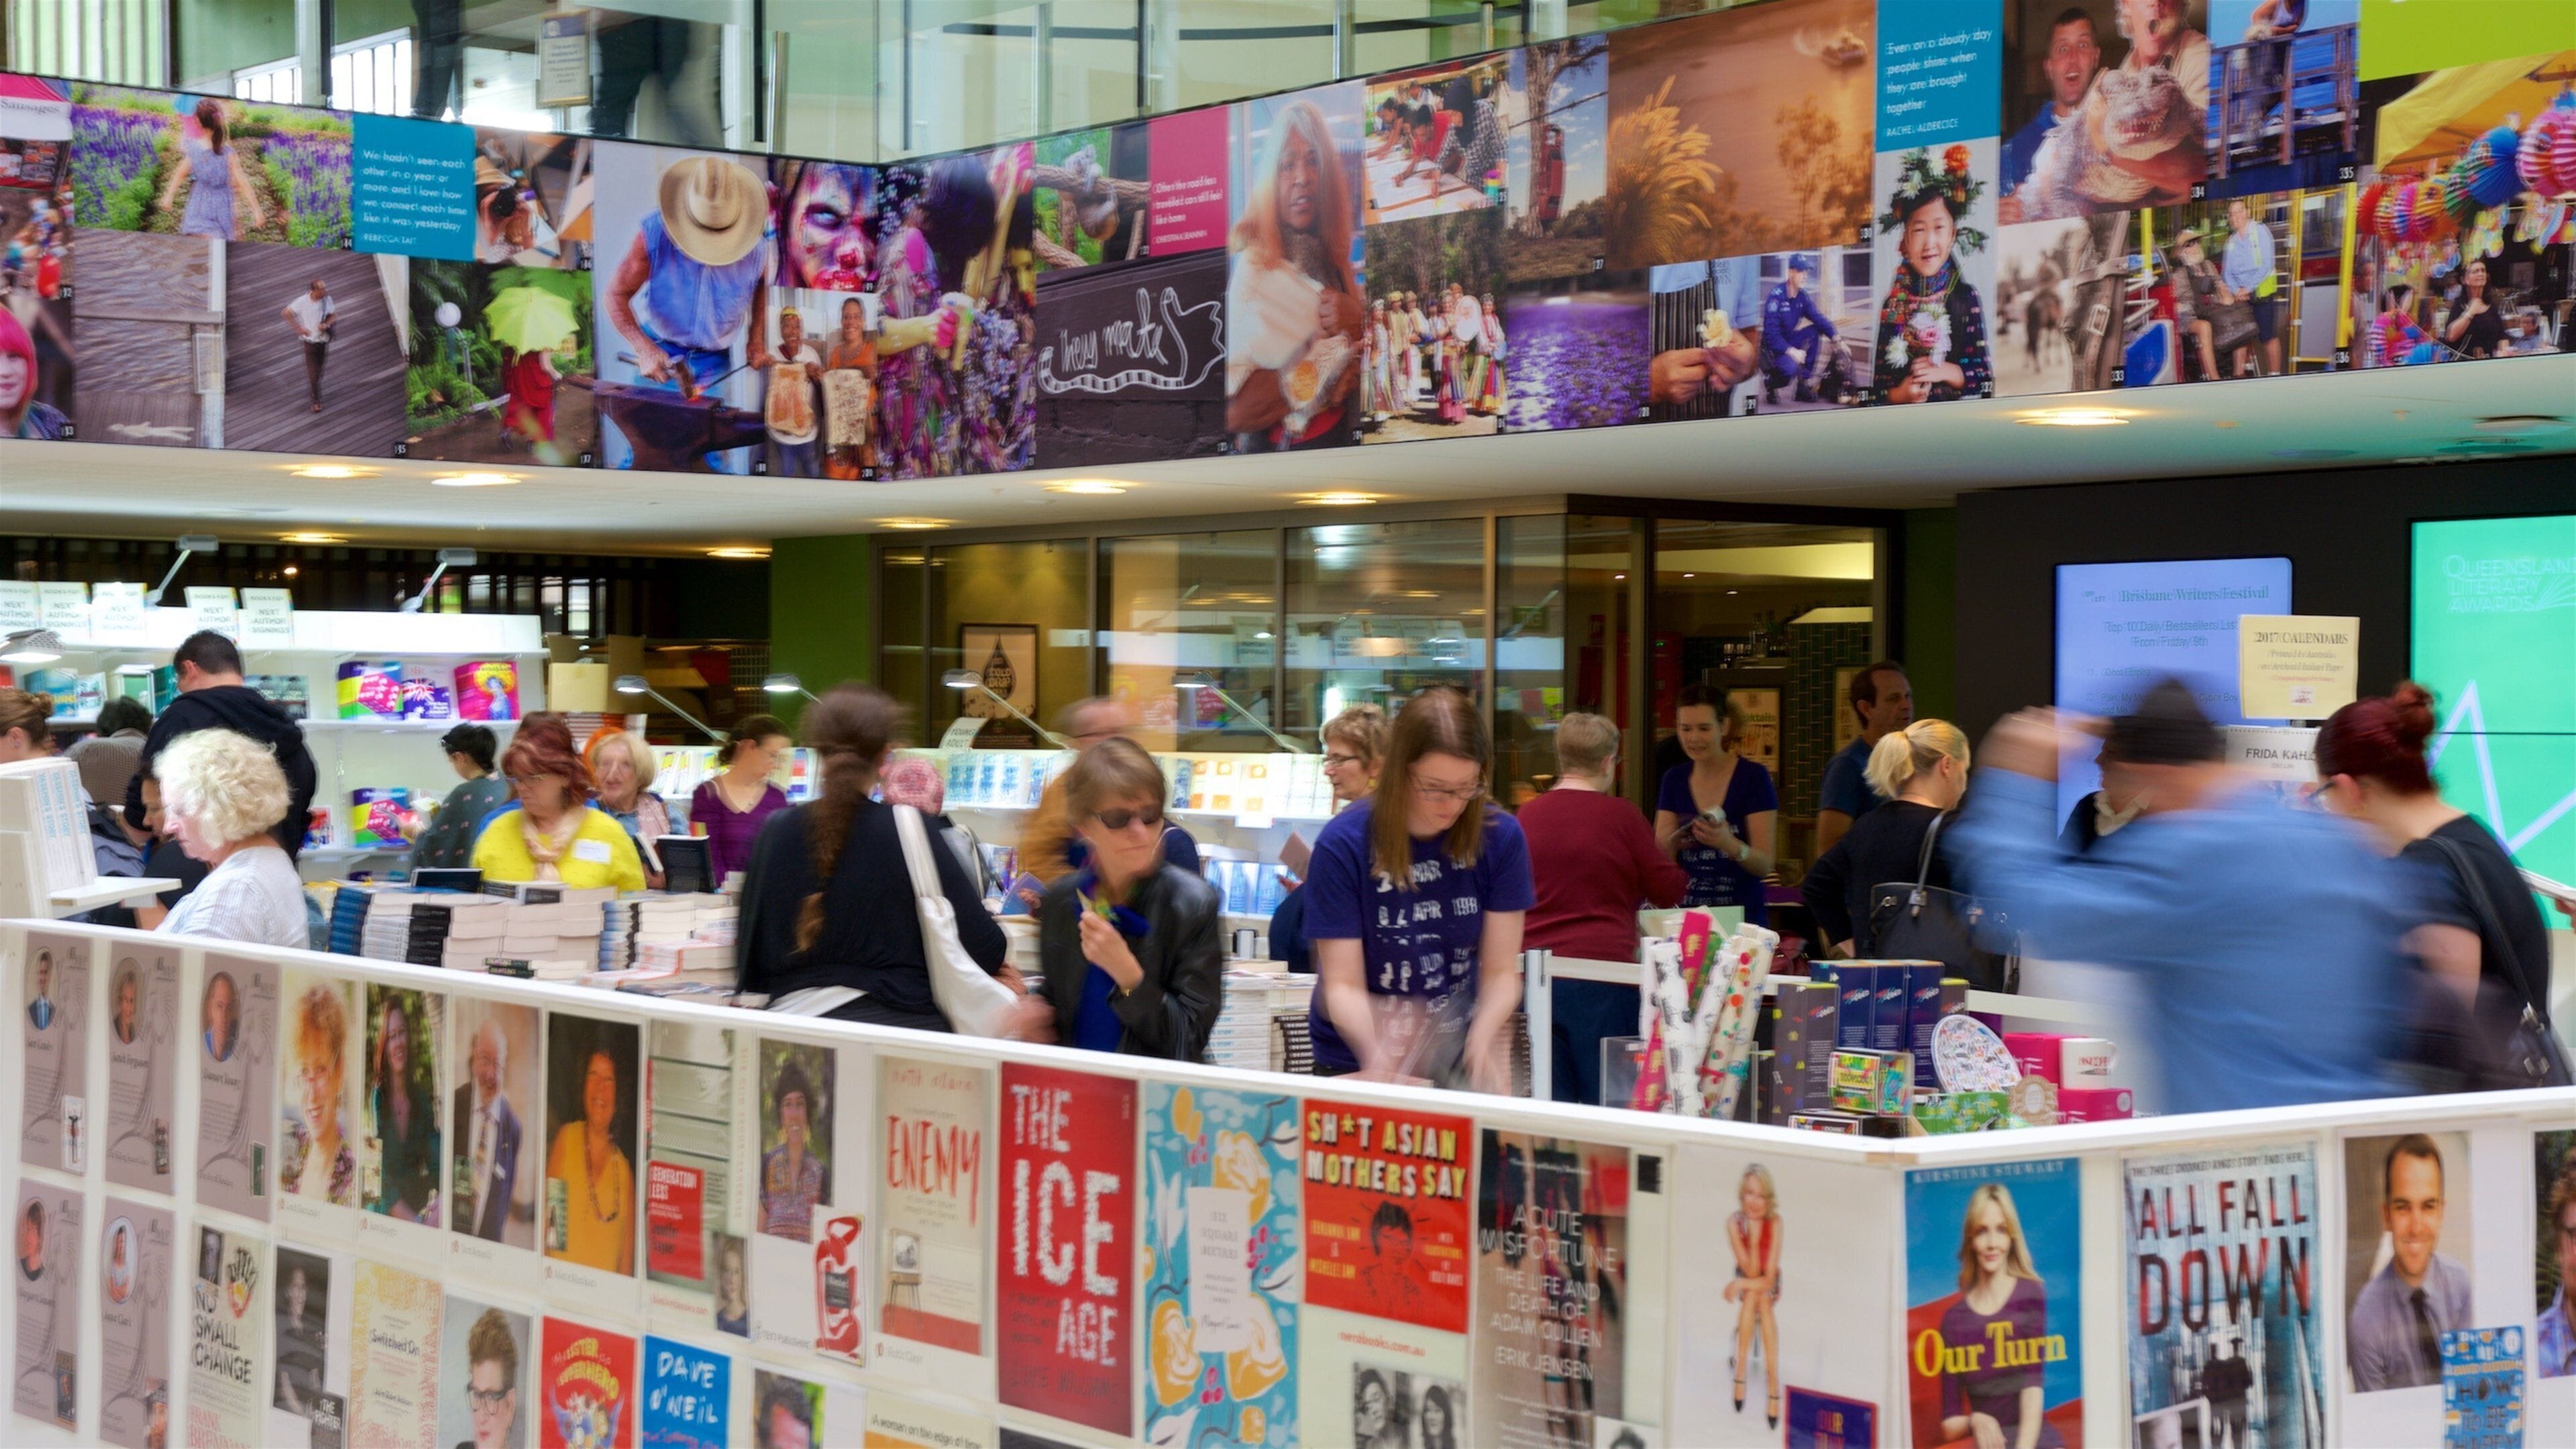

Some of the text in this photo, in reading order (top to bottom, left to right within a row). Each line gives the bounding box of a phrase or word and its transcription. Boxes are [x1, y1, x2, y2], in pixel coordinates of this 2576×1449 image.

[1886, 43, 1911, 54] Even
[1913, 42, 1925, 50] on
[1939, 31, 1970, 46] cloudy
[1973, 28, 1992, 42] day
[1886, 50, 1976, 76] people shine when
[1887, 71, 1967, 95] they are brought
[1887, 98, 1926, 115] together
[364, 150, 380, 160] We
[383, 150, 414, 163] hadn't
[442, 159, 465, 168] each
[363, 166, 388, 176] other
[392, 169, 401, 177] in
[414, 173, 435, 183] year
[363, 184, 463, 199] more and love how
[382, 201, 419, 211] connect
[421, 203, 445, 213] each
[447, 206, 468, 215] time
[392, 218, 412, 226] was
[415, 219, 461, 233] yesterday
[2119, 585, 2269, 602] Brisbane Writers Festival
[2449, 576, 2541, 596] LITERARY
[2448, 596, 2534, 613] AWARDS
[2105, 621, 2122, 633] Top
[2139, 621, 2161, 633] Daily
[2163, 620, 2217, 631] Bestsellers
[2253, 632, 2349, 644] 2017 CALENDARS
[2131, 637, 2158, 647] From
[2160, 637, 2191, 648] Friday
[2199, 694, 2221, 705] Cyber
[2246, 748, 2278, 759] FRIDA
[1412, 900, 1442, 922] APR
[1011, 1083, 1071, 1152] THE
[1382, 1120, 1456, 1161] ASIAN
[651, 1166, 698, 1189] GENERATION
[886, 1114, 981, 1229] ENEMY
[1305, 1150, 1417, 1197] MOTHERS
[1422, 1165, 1467, 1199] SAY
[1914, 1160, 2065, 1186] KIRSTINE STEWART
[2140, 1174, 2310, 1240] ALL FALL
[1013, 1159, 1120, 1297] ICE
[1511, 1204, 1583, 1237] ACUTE
[1480, 1228, 1618, 1273] MISFORTUNE
[1495, 1267, 1601, 1303] THE LIFE AND
[2140, 1236, 2311, 1337] DOWN
[195, 1289, 217, 1315] NO
[1507, 1291, 1586, 1322] DEATH OF
[193, 1315, 241, 1352] SMALL
[1055, 1297, 1118, 1366] AGE
[1489, 1312, 1603, 1349] ADAM CULLEN
[1914, 1320, 2068, 1379] Our Turn
[192, 1342, 252, 1385] CHANGE
[657, 1351, 717, 1389] DAVE
[1495, 1346, 1594, 1381] ERIK JENSEN
[2458, 1375, 2516, 1403] HOW
[880, 1418, 908, 1432] woman
[908, 1426, 920, 1436] on
[934, 1431, 953, 1446] edge
